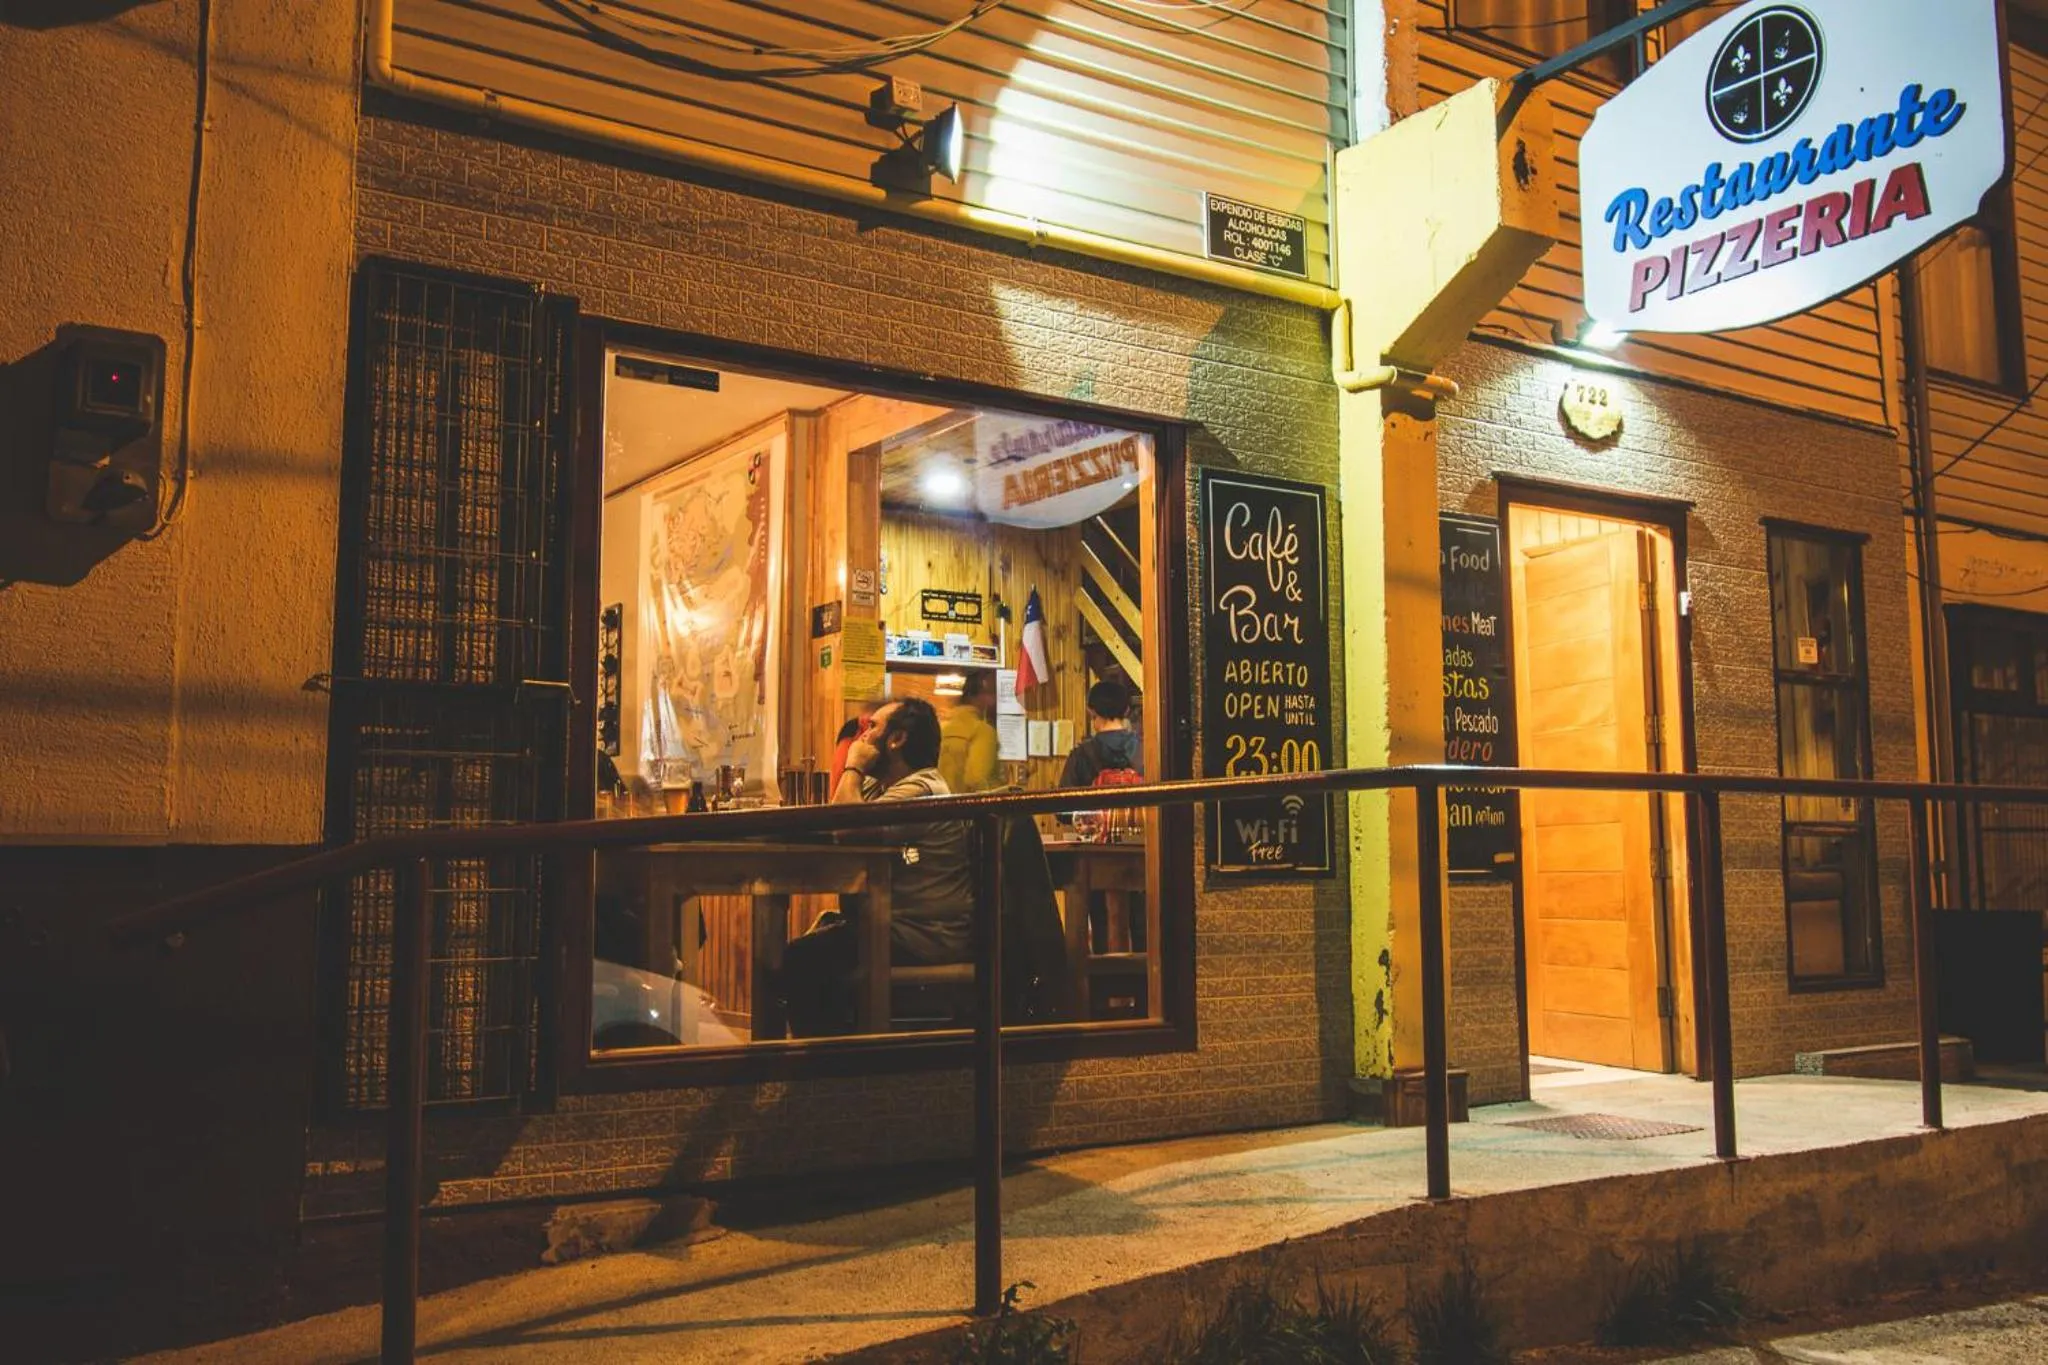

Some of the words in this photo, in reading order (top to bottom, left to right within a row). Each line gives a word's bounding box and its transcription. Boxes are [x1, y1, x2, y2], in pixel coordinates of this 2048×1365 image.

[1604, 83, 1966, 253] Restaurante
[1210, 199, 1252, 220] EXPENDIO
[1254, 211, 1265, 223] DE
[1266, 213, 1302, 232] BEBIDAS
[1228, 218, 1287, 242] ALCOHOLICAS
[1628, 162, 1931, 313] PIZZERIA
[1233, 246, 1268, 265] CLASE
[1576, 384, 1608, 407] 722
[1224, 501, 1300, 592] Café
[1450, 545, 1491, 573] Food
[1285, 570, 1304, 602] &
[1219, 584, 1304, 645] Bar
[1224, 659, 1309, 688] ABIERTO
[1225, 692, 1281, 720] OPEN
[1284, 694, 1316, 712] HASTA
[1285, 712, 1316, 726] UNTIL
[1455, 706, 1499, 735] Pescado
[1225, 733, 1321, 778] 23:00
[1248, 840, 1283, 863] Free
